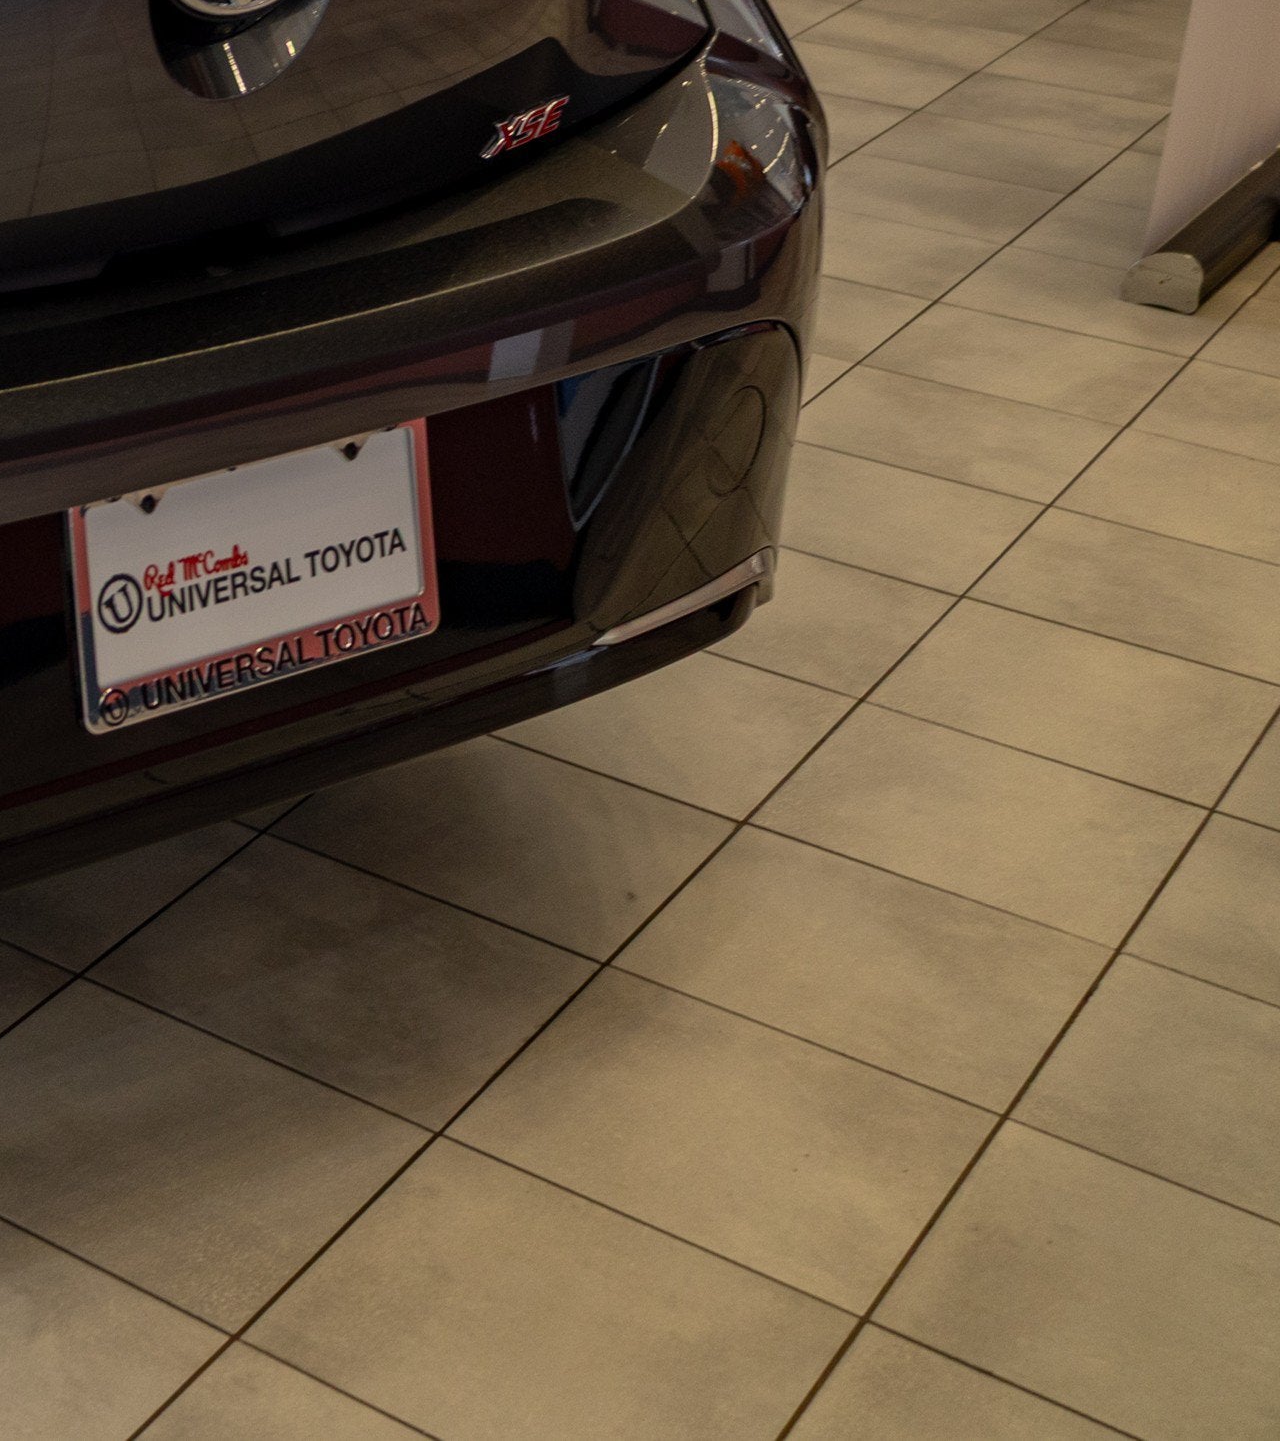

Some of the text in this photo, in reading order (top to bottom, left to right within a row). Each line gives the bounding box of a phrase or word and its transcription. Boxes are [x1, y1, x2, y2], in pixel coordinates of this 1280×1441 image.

[143, 544, 249, 598] Red McCombs
[146, 557, 302, 622] UNIVERSAL
[304, 526, 407, 578] TOYOTA
[140, 636, 315, 711] UNIVERSAL
[313, 601, 431, 659] TOYOTA
